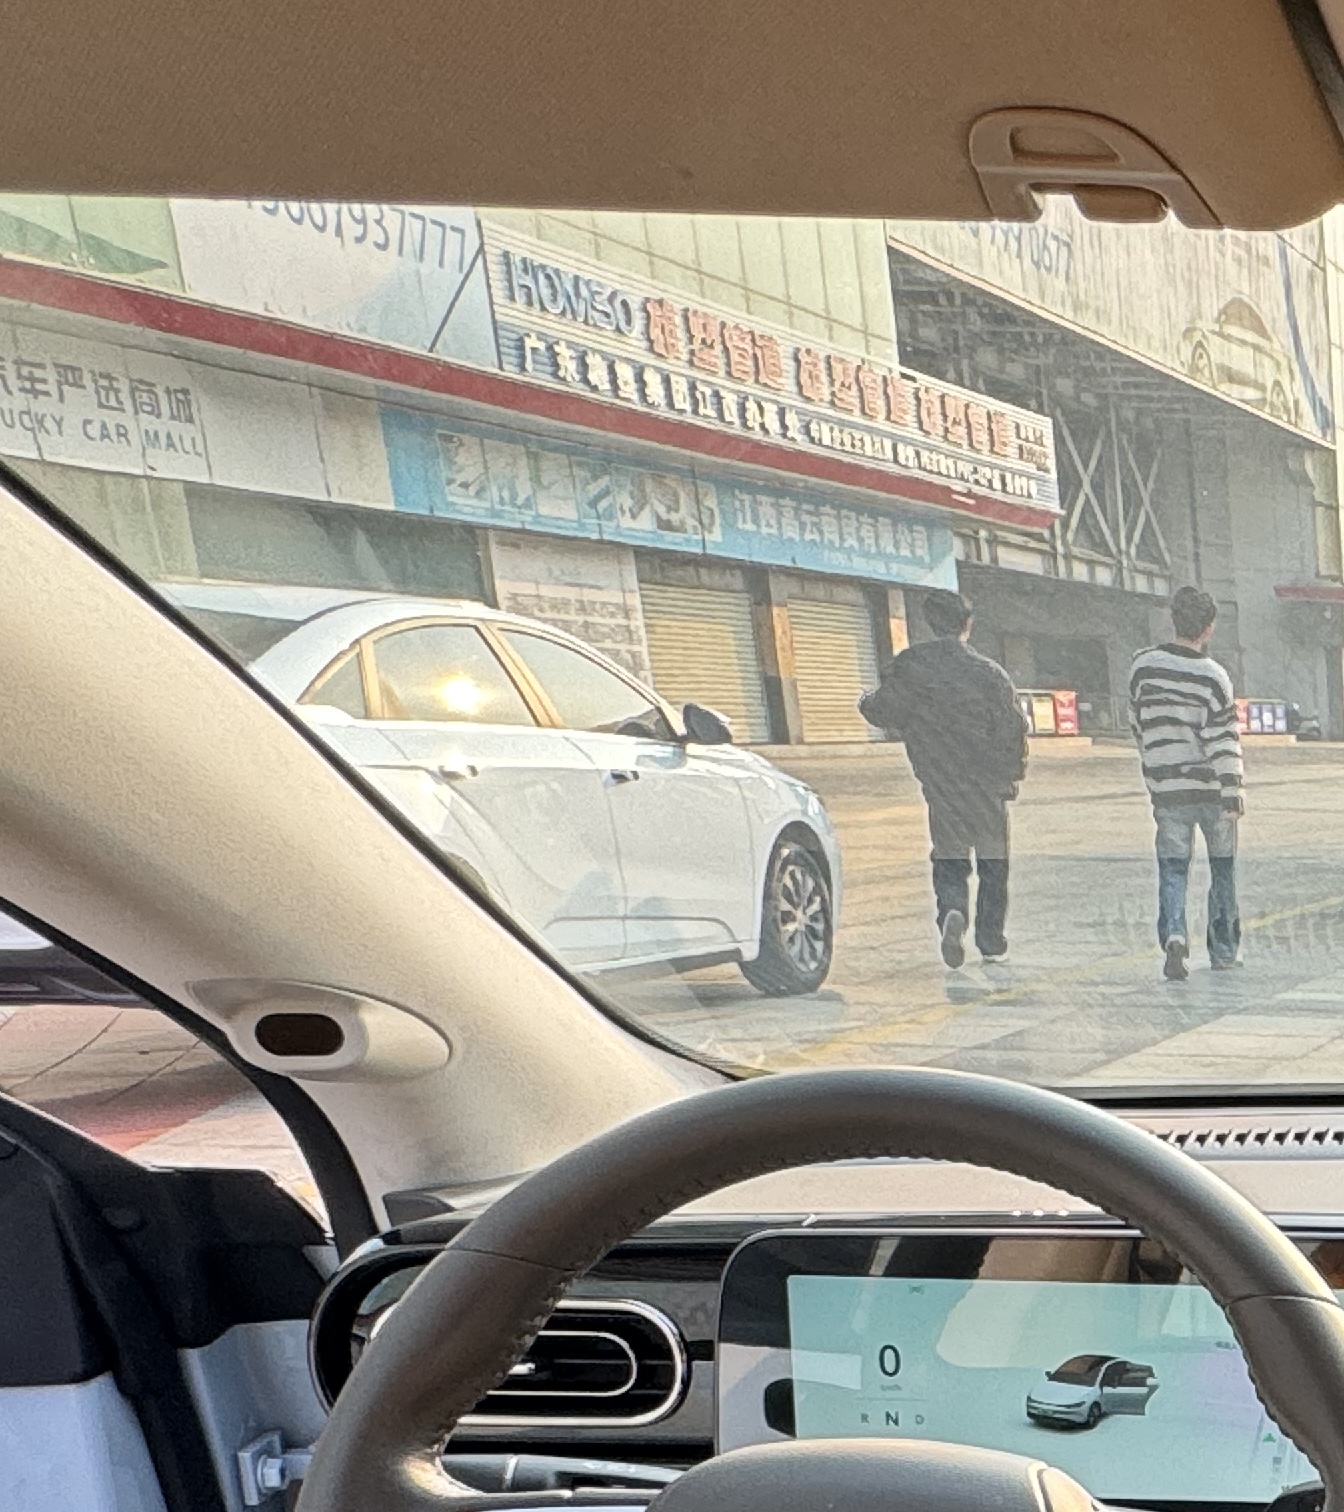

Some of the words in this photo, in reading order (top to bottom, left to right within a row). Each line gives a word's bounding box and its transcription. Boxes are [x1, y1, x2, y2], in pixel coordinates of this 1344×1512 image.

[0, 405, 64, 438] UCKY
[82, 418, 132, 447] CAR
[144, 428, 204, 458] MALL
[879, 1344, 901, 1377] 0
[860, 1412, 870, 1424] R
[884, 1410, 900, 1427] N
[915, 1414, 925, 1426] D
